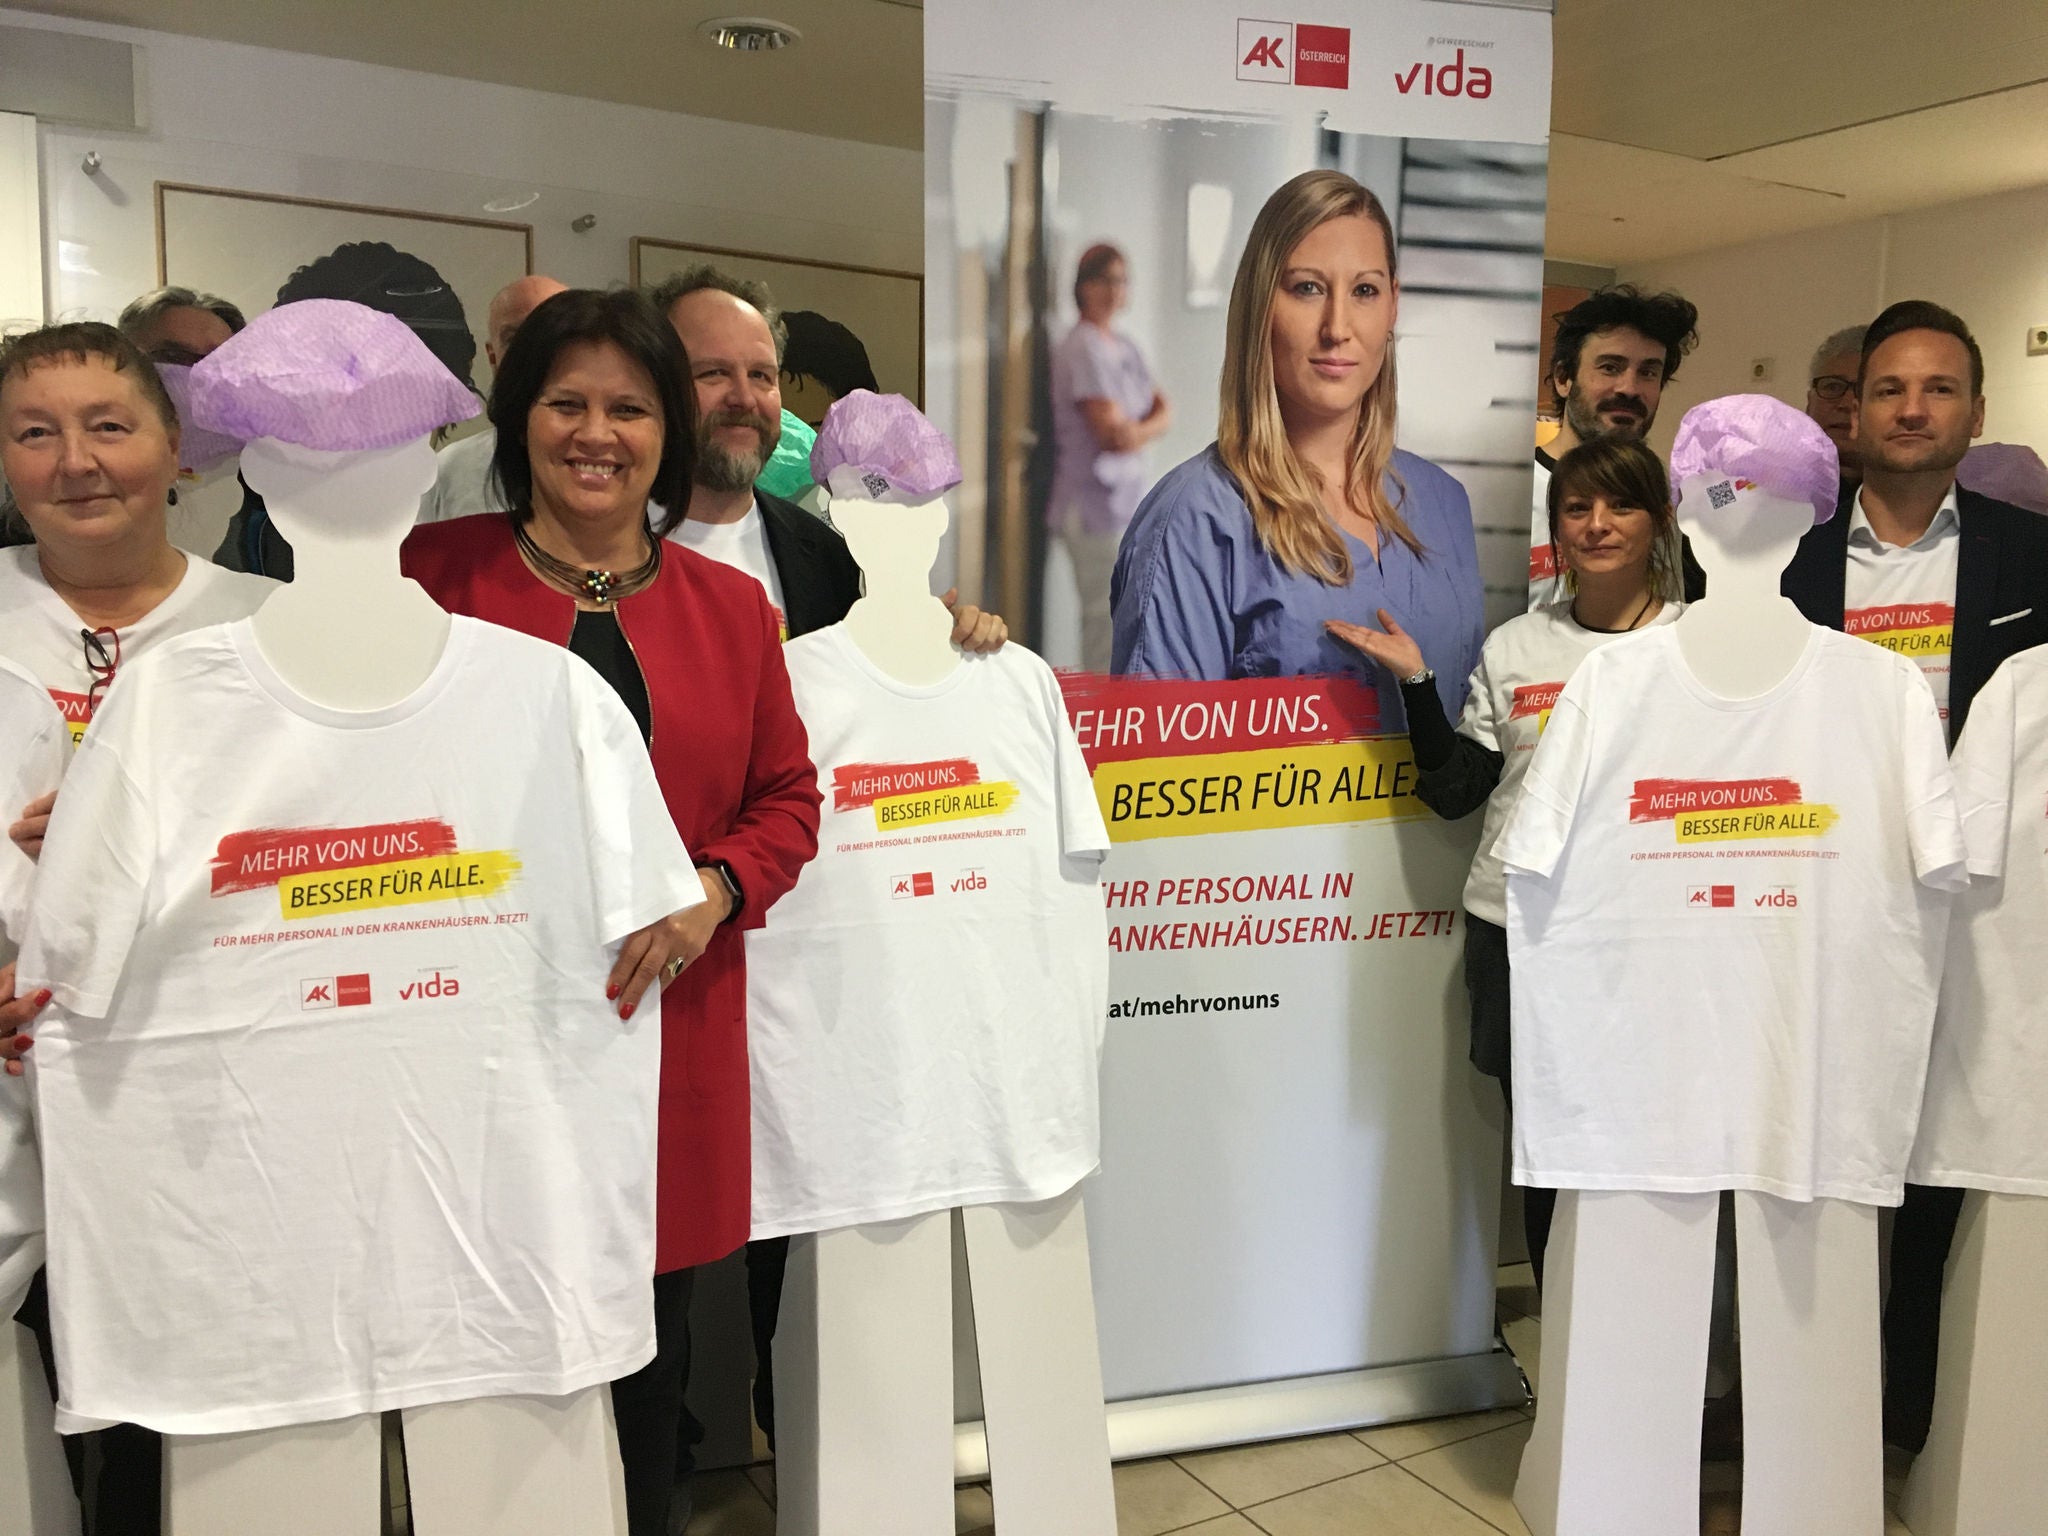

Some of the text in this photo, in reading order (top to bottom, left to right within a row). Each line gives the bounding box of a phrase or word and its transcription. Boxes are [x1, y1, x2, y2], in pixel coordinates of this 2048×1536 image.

[1242, 36, 1346, 69] AK ÖSTERREICH
[1394, 48, 1493, 99] vida
[1861, 612, 1895, 629] VON
[1900, 610, 1934, 625] UNS.
[1900, 634, 1931, 650] FÜR
[54, 700, 87, 717] ON
[1074, 694, 1329, 749] EHR VON UNS.
[850, 766, 960, 798] MEHR VON UNS.
[1110, 775, 1242, 822] BESSER
[1251, 763, 1321, 810] FÜR
[1650, 785, 1778, 810] MEHR VON UNS.
[882, 791, 998, 823] BESSER FÜR ALLE.
[1682, 812, 1820, 836] BESSER FÜR ALLE.
[240, 831, 425, 875] MEHR VON UNS.
[836, 843, 851, 853] FÜR
[853, 840, 874, 851] MEHR
[875, 837, 912, 849] PERSONAL
[913, 836, 921, 844] IN
[922, 835, 938, 844] DEN
[1630, 852, 1647, 860] FÜR
[1648, 851, 1671, 860] MEHR
[1672, 850, 1714, 859] PERSONAL
[1727, 850, 1744, 858] DEN
[290, 864, 485, 909] BESSER FÜR ALLE.
[894, 871, 987, 894] AK vida
[1101, 872, 1354, 908] HR PERSONAL IN
[1755, 888, 1797, 907] vida
[213, 912, 529, 948] FÜR MEHR PERSONAL IN DEN KRANKENHÄUSERN. JETZT!
[1107, 910, 1456, 953] ANKENHÄUSERN. JETZT!
[305, 971, 459, 1002] AK vida
